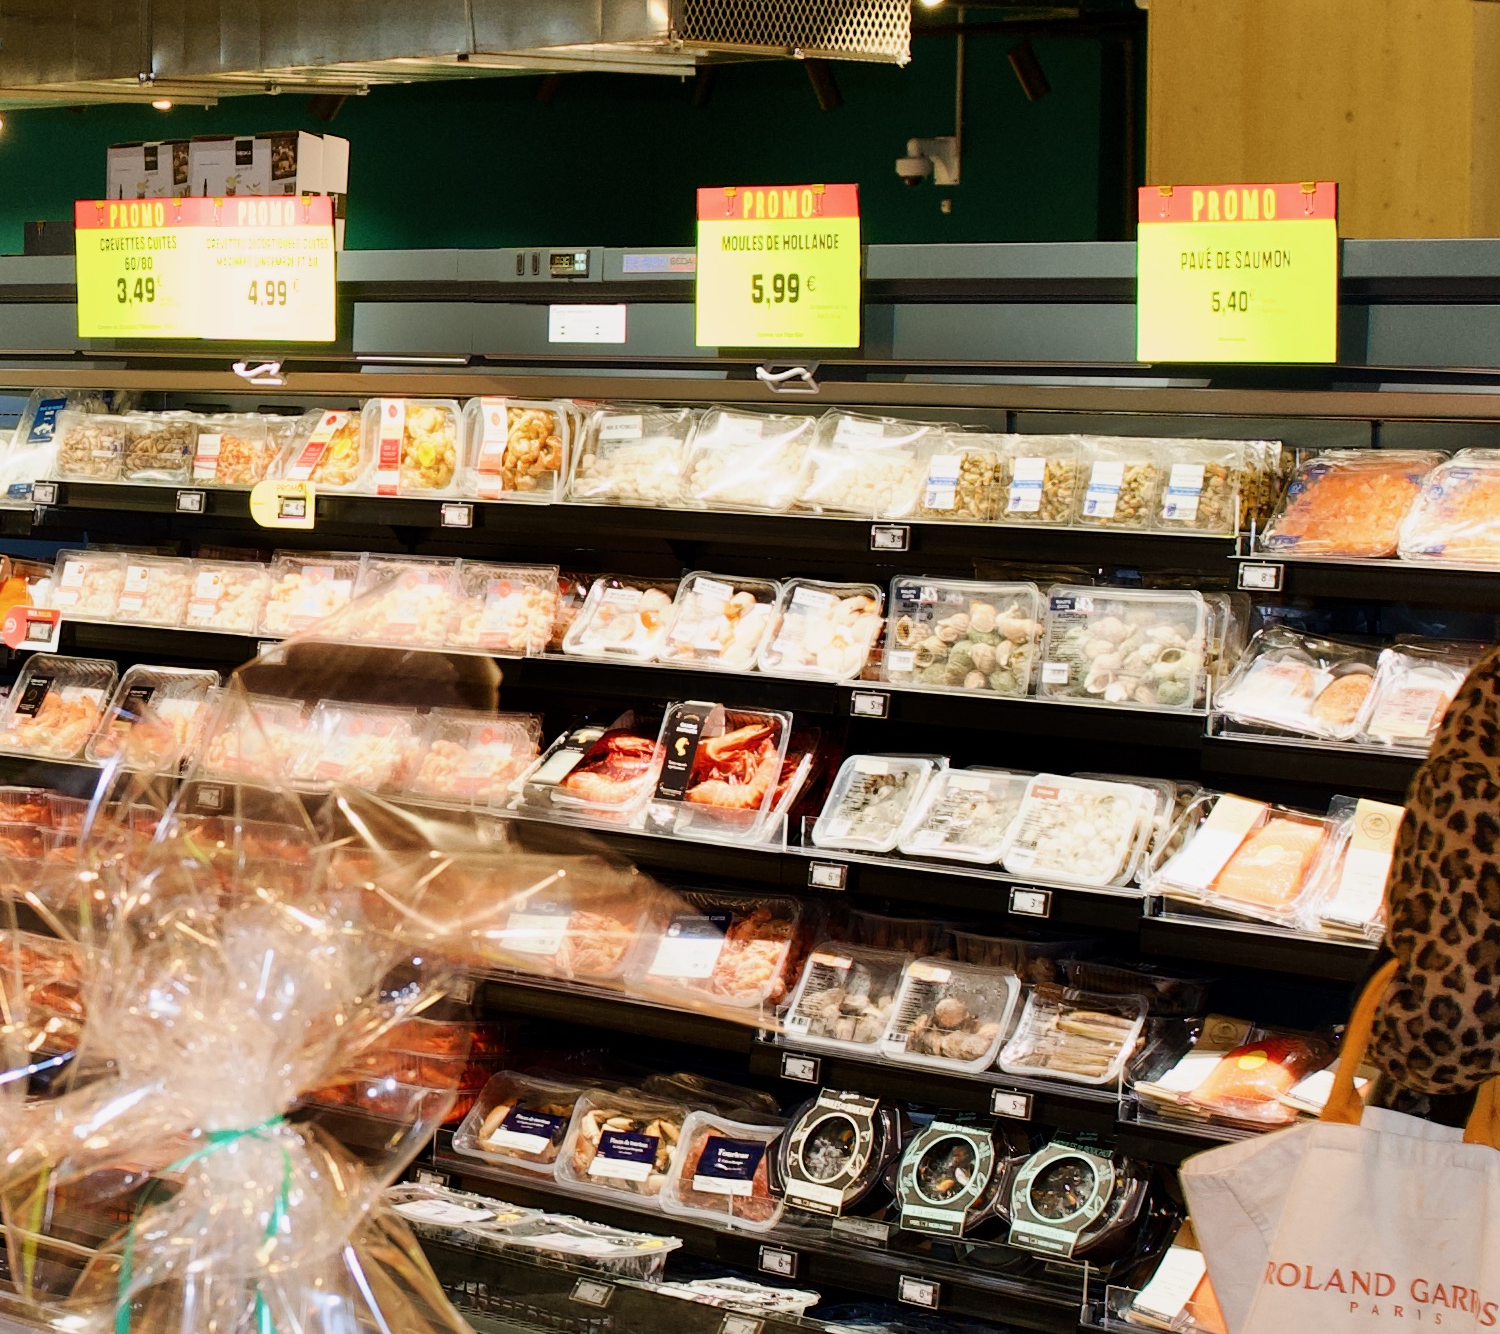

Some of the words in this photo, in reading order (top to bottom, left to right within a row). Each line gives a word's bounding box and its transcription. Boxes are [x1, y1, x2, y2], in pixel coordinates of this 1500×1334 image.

[110, 202, 165, 229] PROMO
[238, 200, 296, 226] PROMO
[743, 189, 812, 219] PROMO
[1193, 189, 1277, 221] PROMO
[100, 237, 145, 251] CREVETTES
[147, 235, 178, 250] CUITES
[721, 235, 763, 251] MOULES
[766, 235, 780, 250] DE
[783, 233, 840, 250] HOLLANDE
[1181, 247, 1212, 270] PAVÉ
[1217, 252, 1231, 269] DE
[1234, 250, 1292, 269] SAUMON
[751, 273, 800, 309] 5,99
[1349, 1300, 1444, 1326] PARIS
